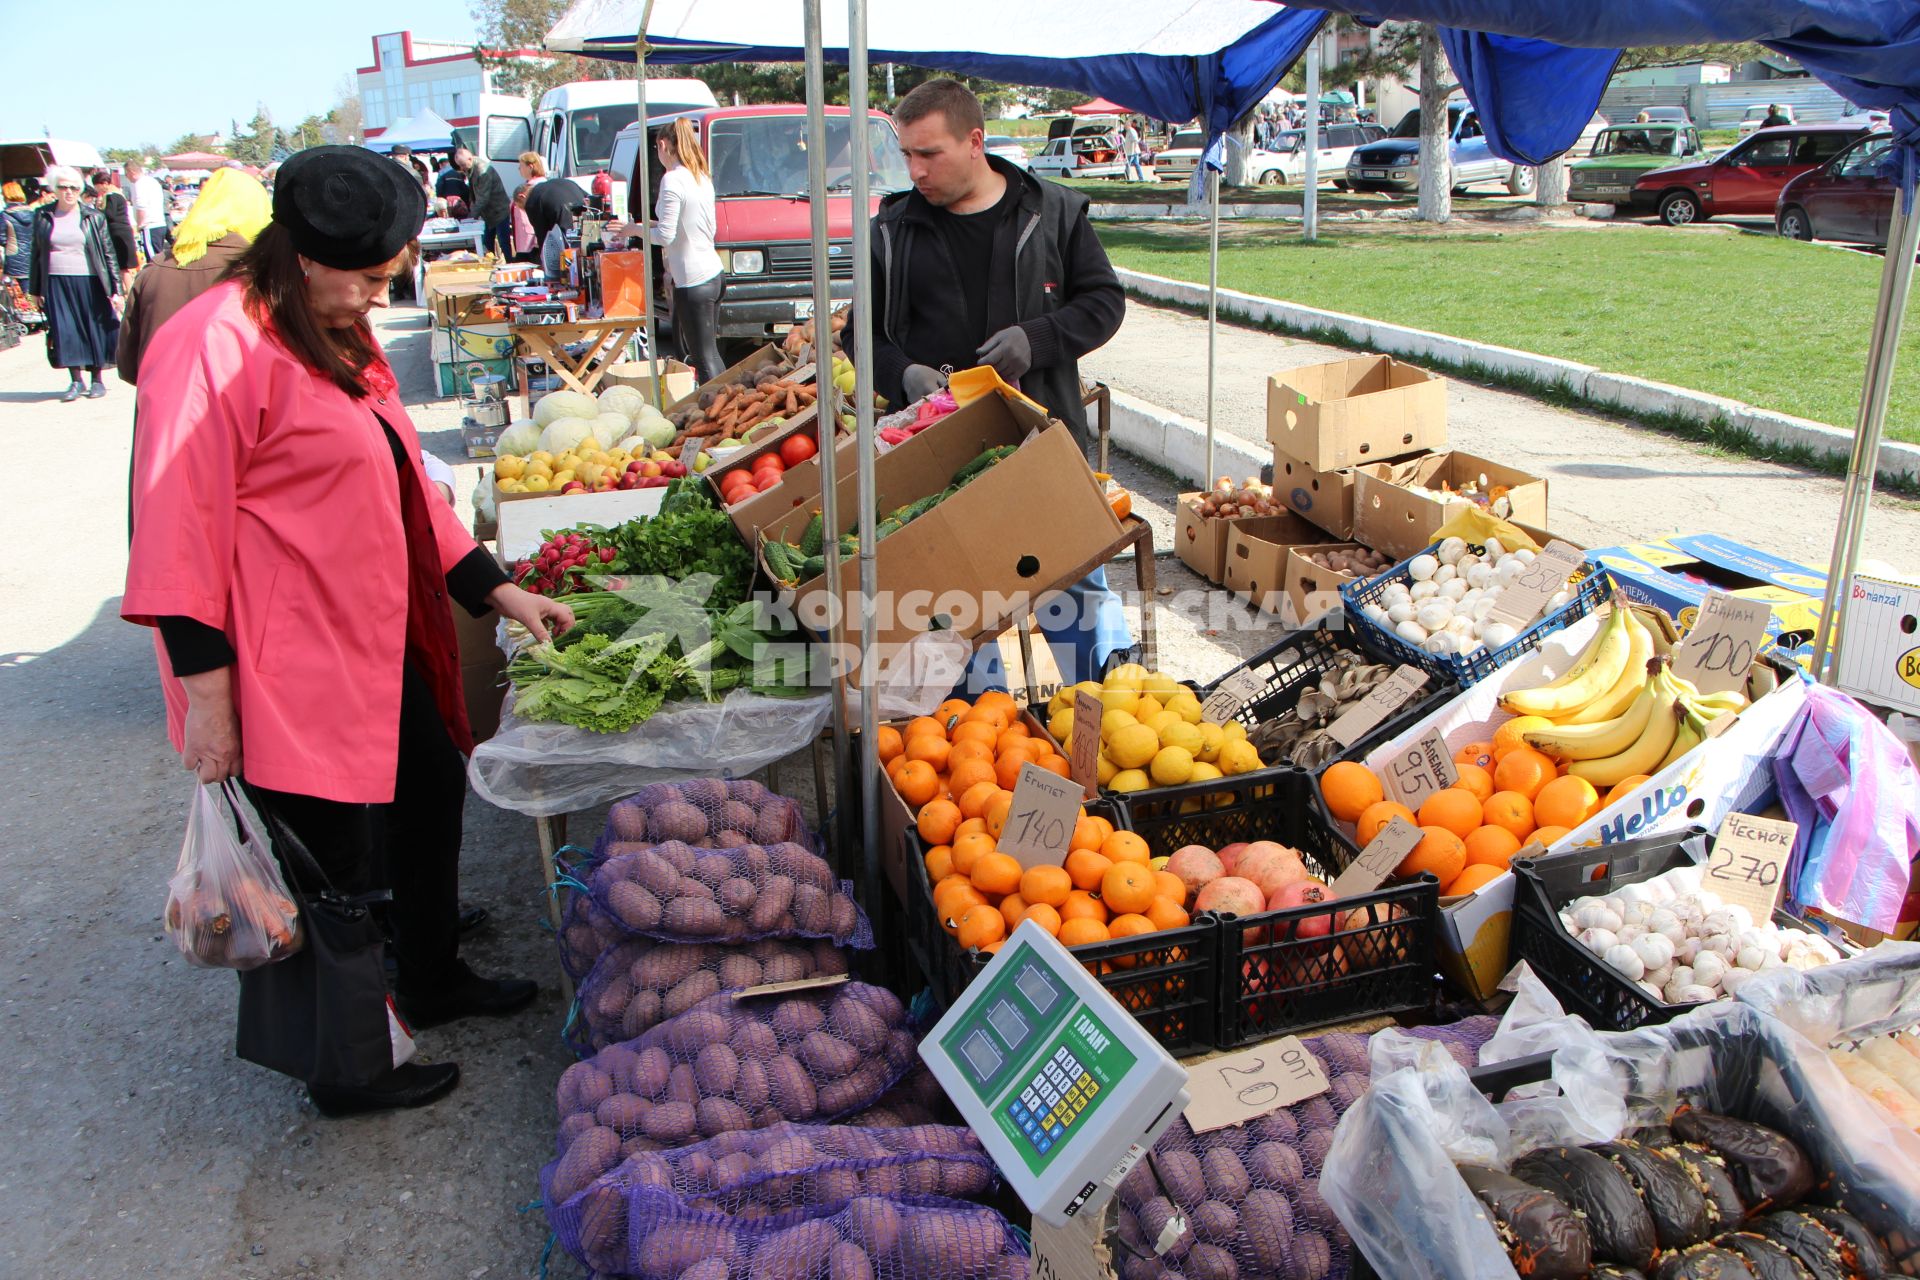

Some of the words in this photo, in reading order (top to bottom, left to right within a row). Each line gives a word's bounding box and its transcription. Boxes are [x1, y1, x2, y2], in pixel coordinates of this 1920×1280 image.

[1519, 561, 1562, 593] 250
[1853, 585, 1902, 608] Bonanza!
[1691, 632, 1753, 677] 100
[1201, 691, 1237, 721] 170
[1371, 681, 1409, 709] 200
[1393, 750, 1433, 794] 95
[1016, 808, 1065, 849] 140
[1600, 784, 1688, 846] Hello
[1357, 839, 1399, 877] 200
[1710, 846, 1779, 887] 270
[1073, 1013, 1111, 1055] ГАРАНТ
[1217, 1057, 1279, 1106] 20
[1067, 1205, 1077, 1215] ON
[1082, 1184, 1095, 1198] OFF
